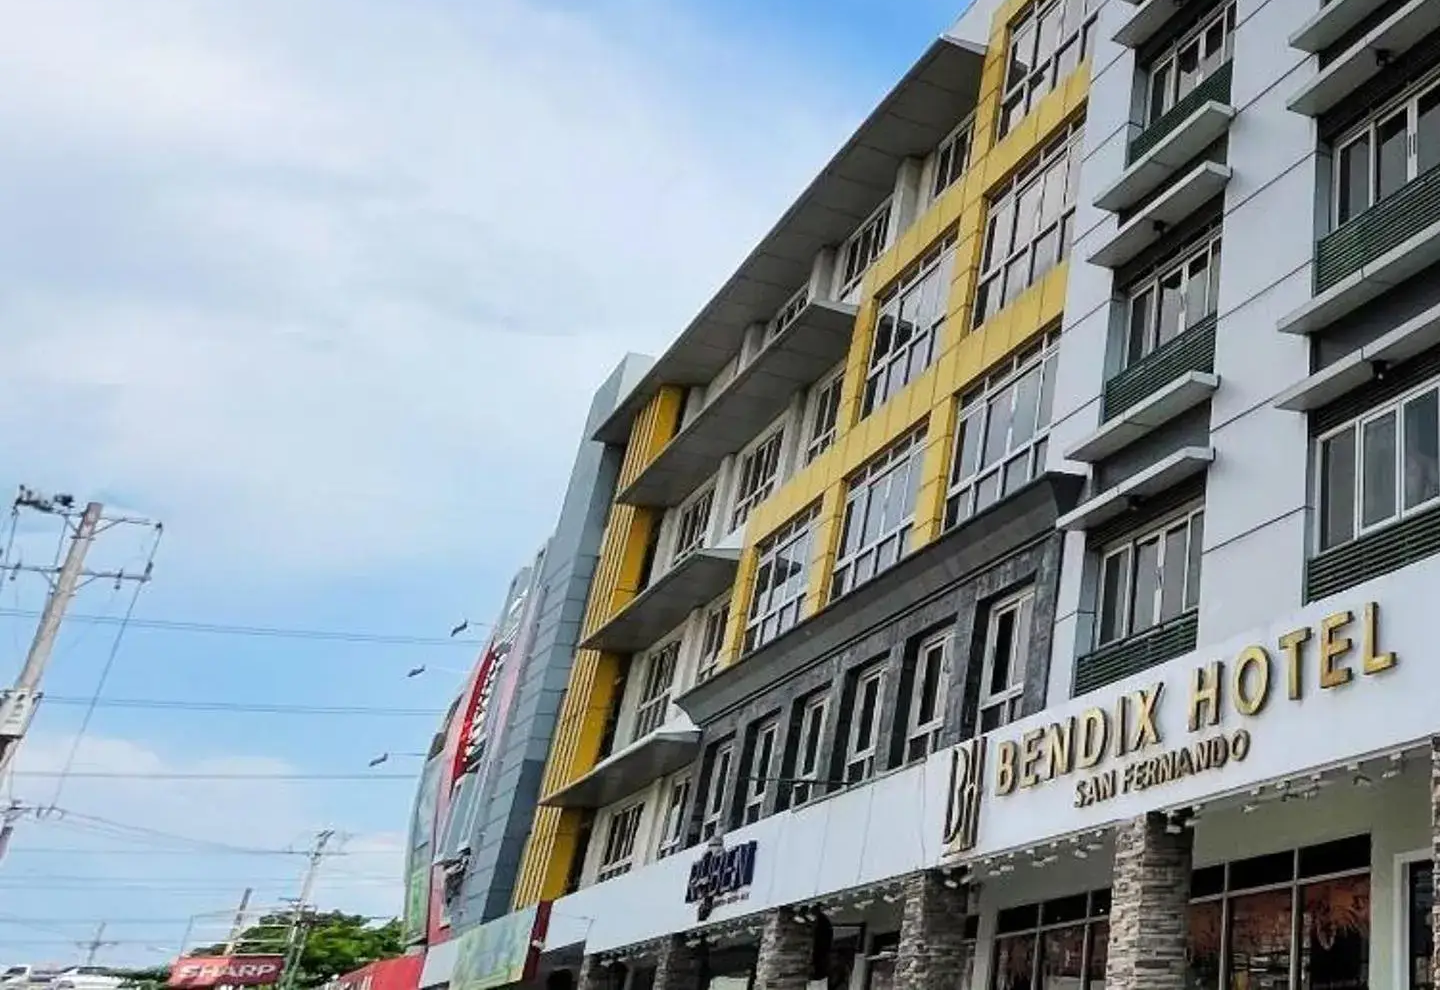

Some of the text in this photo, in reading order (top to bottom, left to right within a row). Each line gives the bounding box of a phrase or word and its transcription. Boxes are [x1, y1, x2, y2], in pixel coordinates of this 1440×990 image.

[995, 601, 1397, 796] BENDIX HOTEL
[1074, 728, 1251, 808] SAN FERNANDO
[179, 963, 277, 978] SHARP
